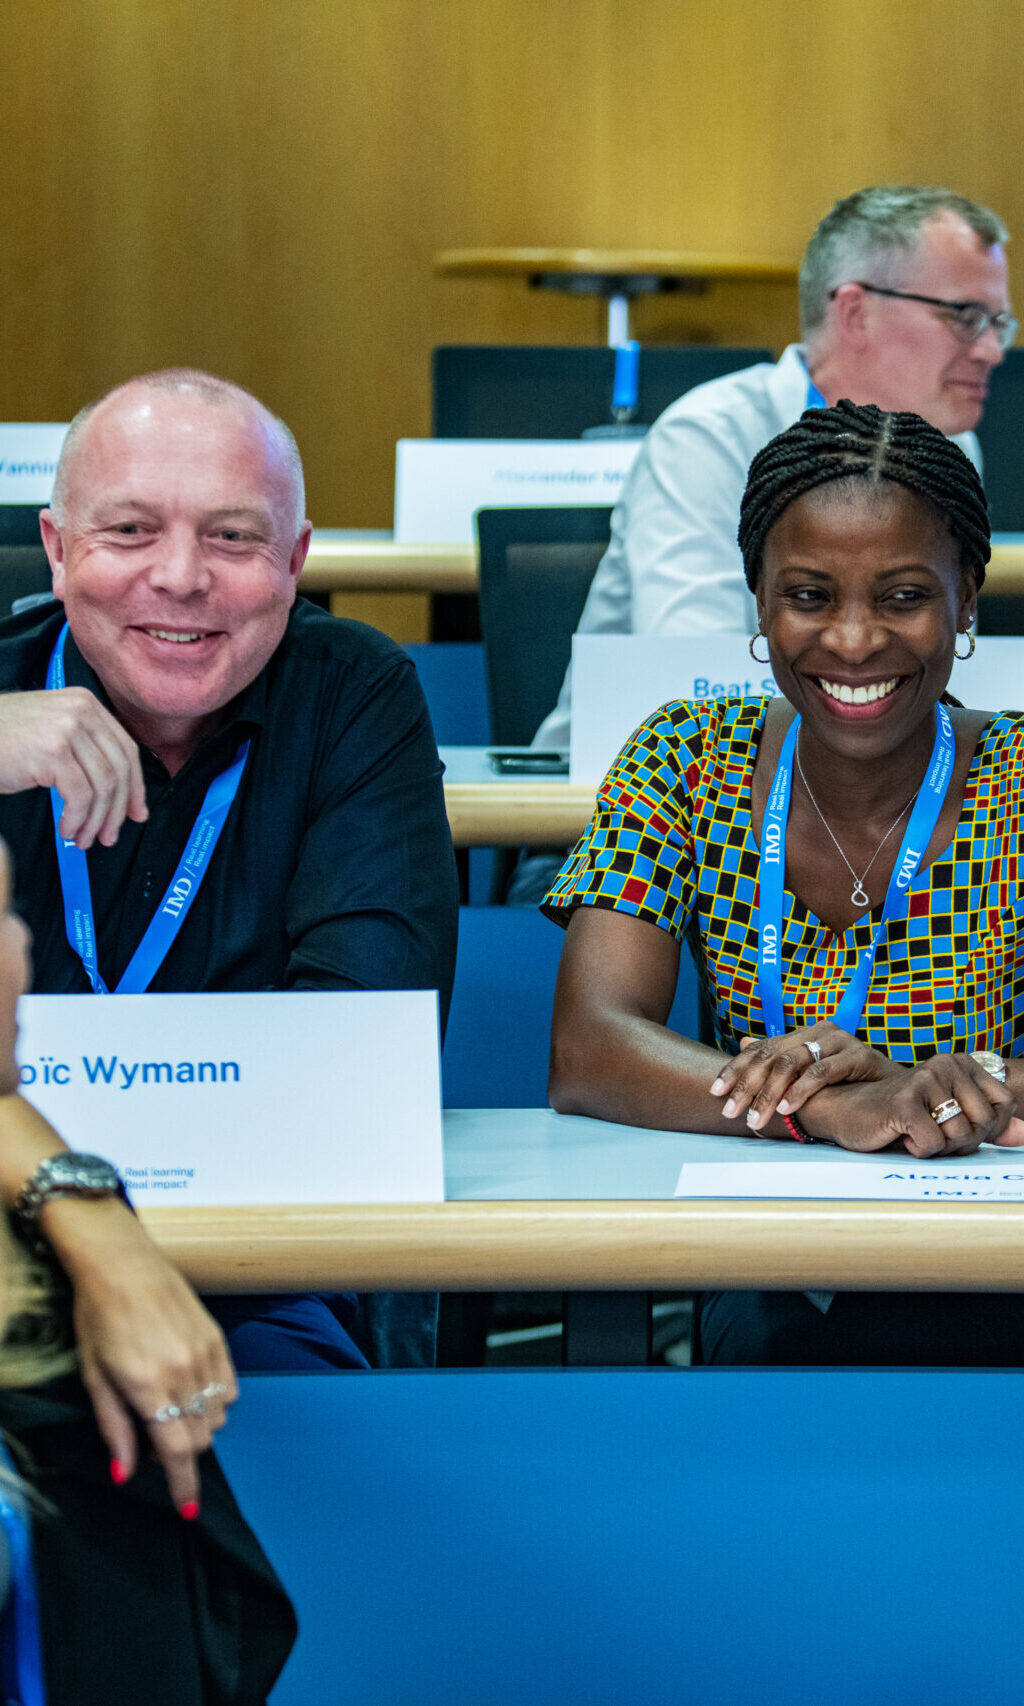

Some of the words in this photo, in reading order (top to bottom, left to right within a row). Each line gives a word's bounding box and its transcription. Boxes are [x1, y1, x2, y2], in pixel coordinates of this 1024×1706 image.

[693, 678, 751, 698] Beat
[764, 823, 781, 865] IMD
[896, 847, 922, 888] IMD
[162, 877, 193, 919] IMD
[762, 923, 777, 966] IMD
[19, 1056, 71, 1085] oïc
[82, 1056, 240, 1090] Wymann
[150, 1167, 194, 1178] learning
